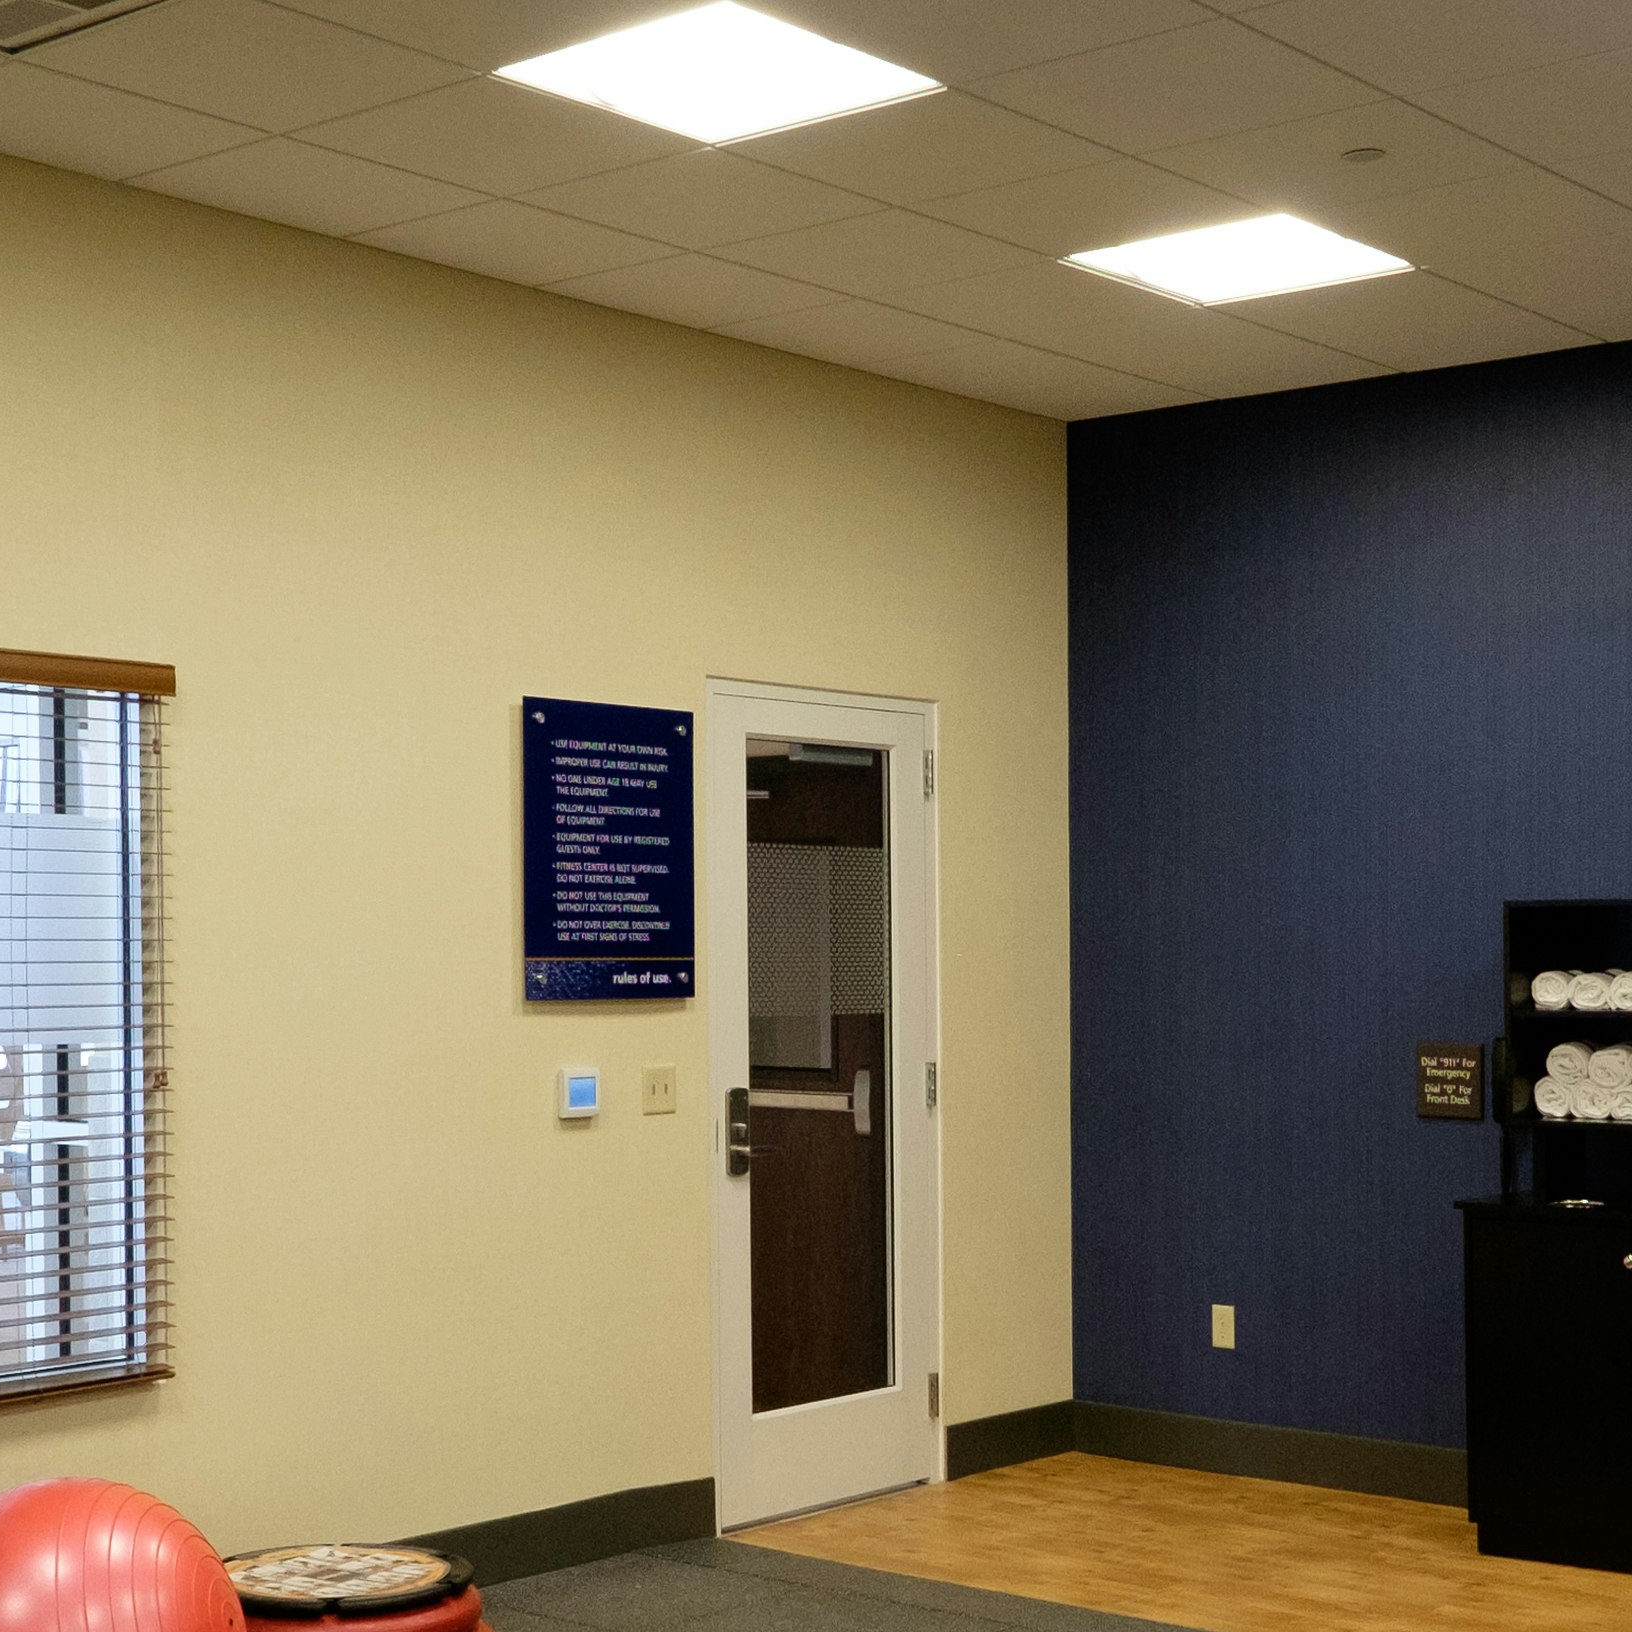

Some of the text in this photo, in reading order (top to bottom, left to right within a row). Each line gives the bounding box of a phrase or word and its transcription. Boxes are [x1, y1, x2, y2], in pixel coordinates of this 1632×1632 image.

[569, 740, 607, 751] EQUIPMENT
[618, 744, 636, 753] YOUR
[637, 745, 653, 754] OWN
[555, 756, 588, 767] IMPROPER
[589, 759, 601, 768] USE
[602, 759, 616, 769] CAN
[617, 760, 638, 770] RESULT
[556, 774, 566, 783] NO
[568, 775, 582, 784] ONE
[583, 775, 605, 785] UNDER
[607, 777, 620, 786] AGE
[556, 786, 569, 795] THE
[556, 803, 584, 813] FOLLOW
[585, 804, 597, 814] ALL
[598, 805, 634, 816] DIRECTIONS
[635, 807, 647, 816] FOR
[556, 815, 566, 824] OF
[556, 832, 670, 846] EQUIPMENT FOR USE BY REGISTERED
[556, 844, 581, 854] GUESTS
[556, 861, 582, 871] FITNESS
[584, 862, 608, 872] CENTER
[609, 863, 615, 872] IS
[617, 864, 630, 873] NOT
[556, 873, 567, 883] DO
[569, 874, 583, 883] NOT
[585, 875, 613, 884] EXERCISE
[556, 891, 649, 901] DO NOT USE THIS EQUIPMENT
[556, 903, 589, 912] WITHOUT
[557, 920, 568, 929] DO
[569, 920, 582, 929] NOT
[584, 921, 601, 929] OVER
[557, 932, 570, 941] USE
[571, 932, 580, 941] AT
[581, 933, 598, 941] FIRST
[599, 933, 617, 941] SIGNS
[619, 933, 627, 941] OF
[613, 971, 671, 984] rules of use.
[1421, 1057, 1437, 1066] Dial
[1462, 1058, 1476, 1068] For
[1426, 1067, 1471, 1080] Emergency
[1424, 1084, 1440, 1093] Dial
[1459, 1085, 1472, 1095] For
[1426, 1095, 1470, 1105] Front Desk
